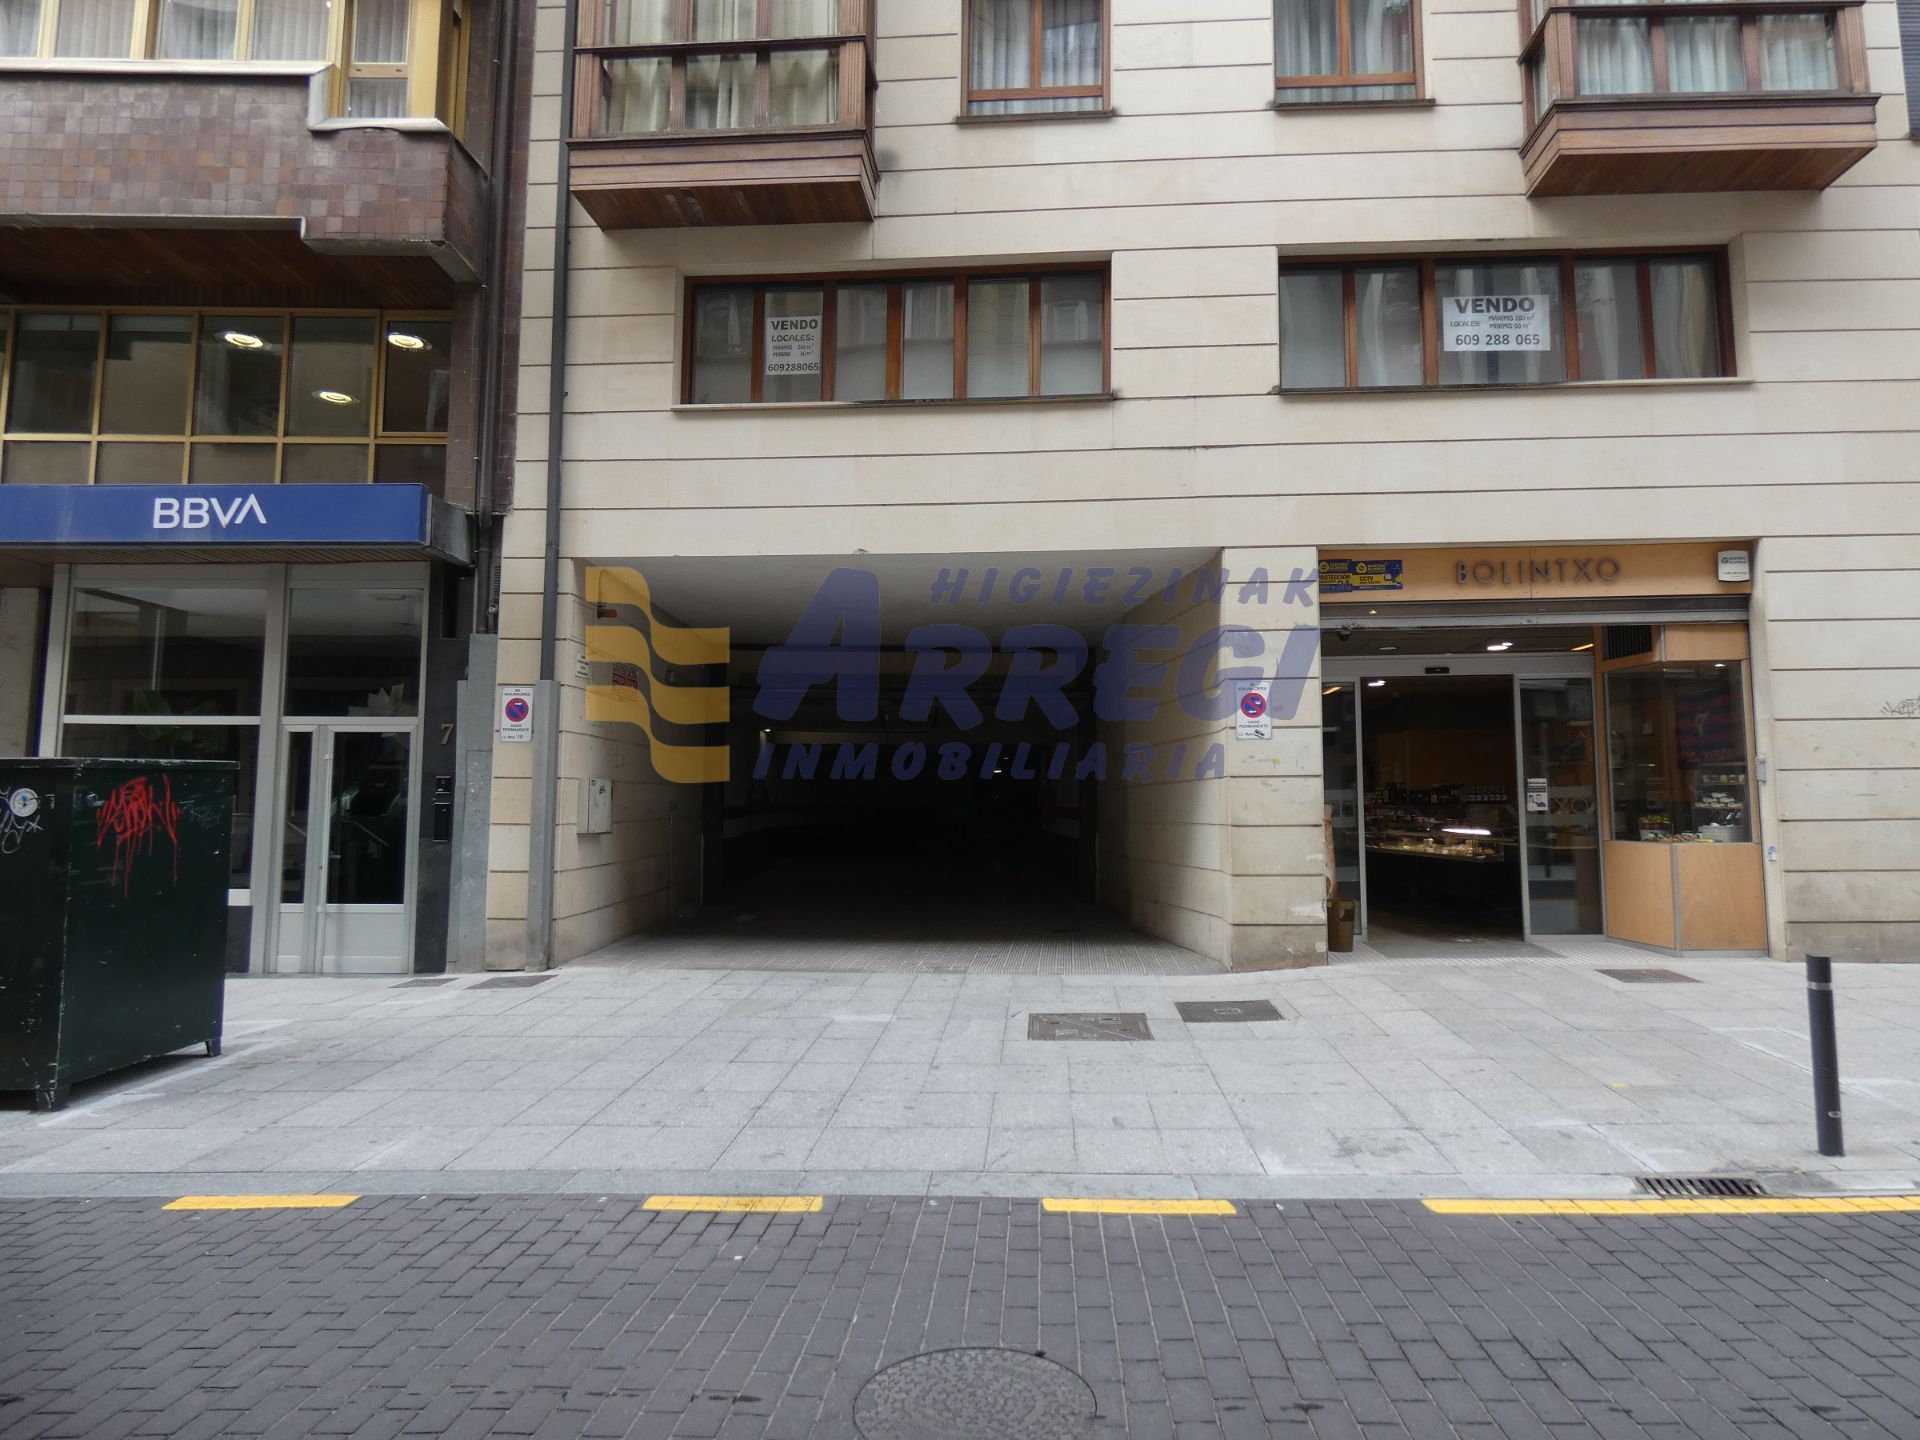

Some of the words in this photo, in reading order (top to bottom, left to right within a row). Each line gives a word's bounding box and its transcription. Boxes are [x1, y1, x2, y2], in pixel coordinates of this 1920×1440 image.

[1454, 297, 1535, 314] VENDO
[771, 319, 819, 331] VENDO
[1450, 320, 1481, 328] LOCALES:
[771, 334, 815, 342] LOCALES:
[1456, 334, 1480, 346] 609
[1485, 334, 1510, 346] 288
[1515, 334, 1540, 345] 065
[768, 362, 820, 372] 609288065
[153, 493, 268, 529] BBVA
[1456, 558, 1621, 585] BOLINTXO
[440, 723, 454, 745] 7
